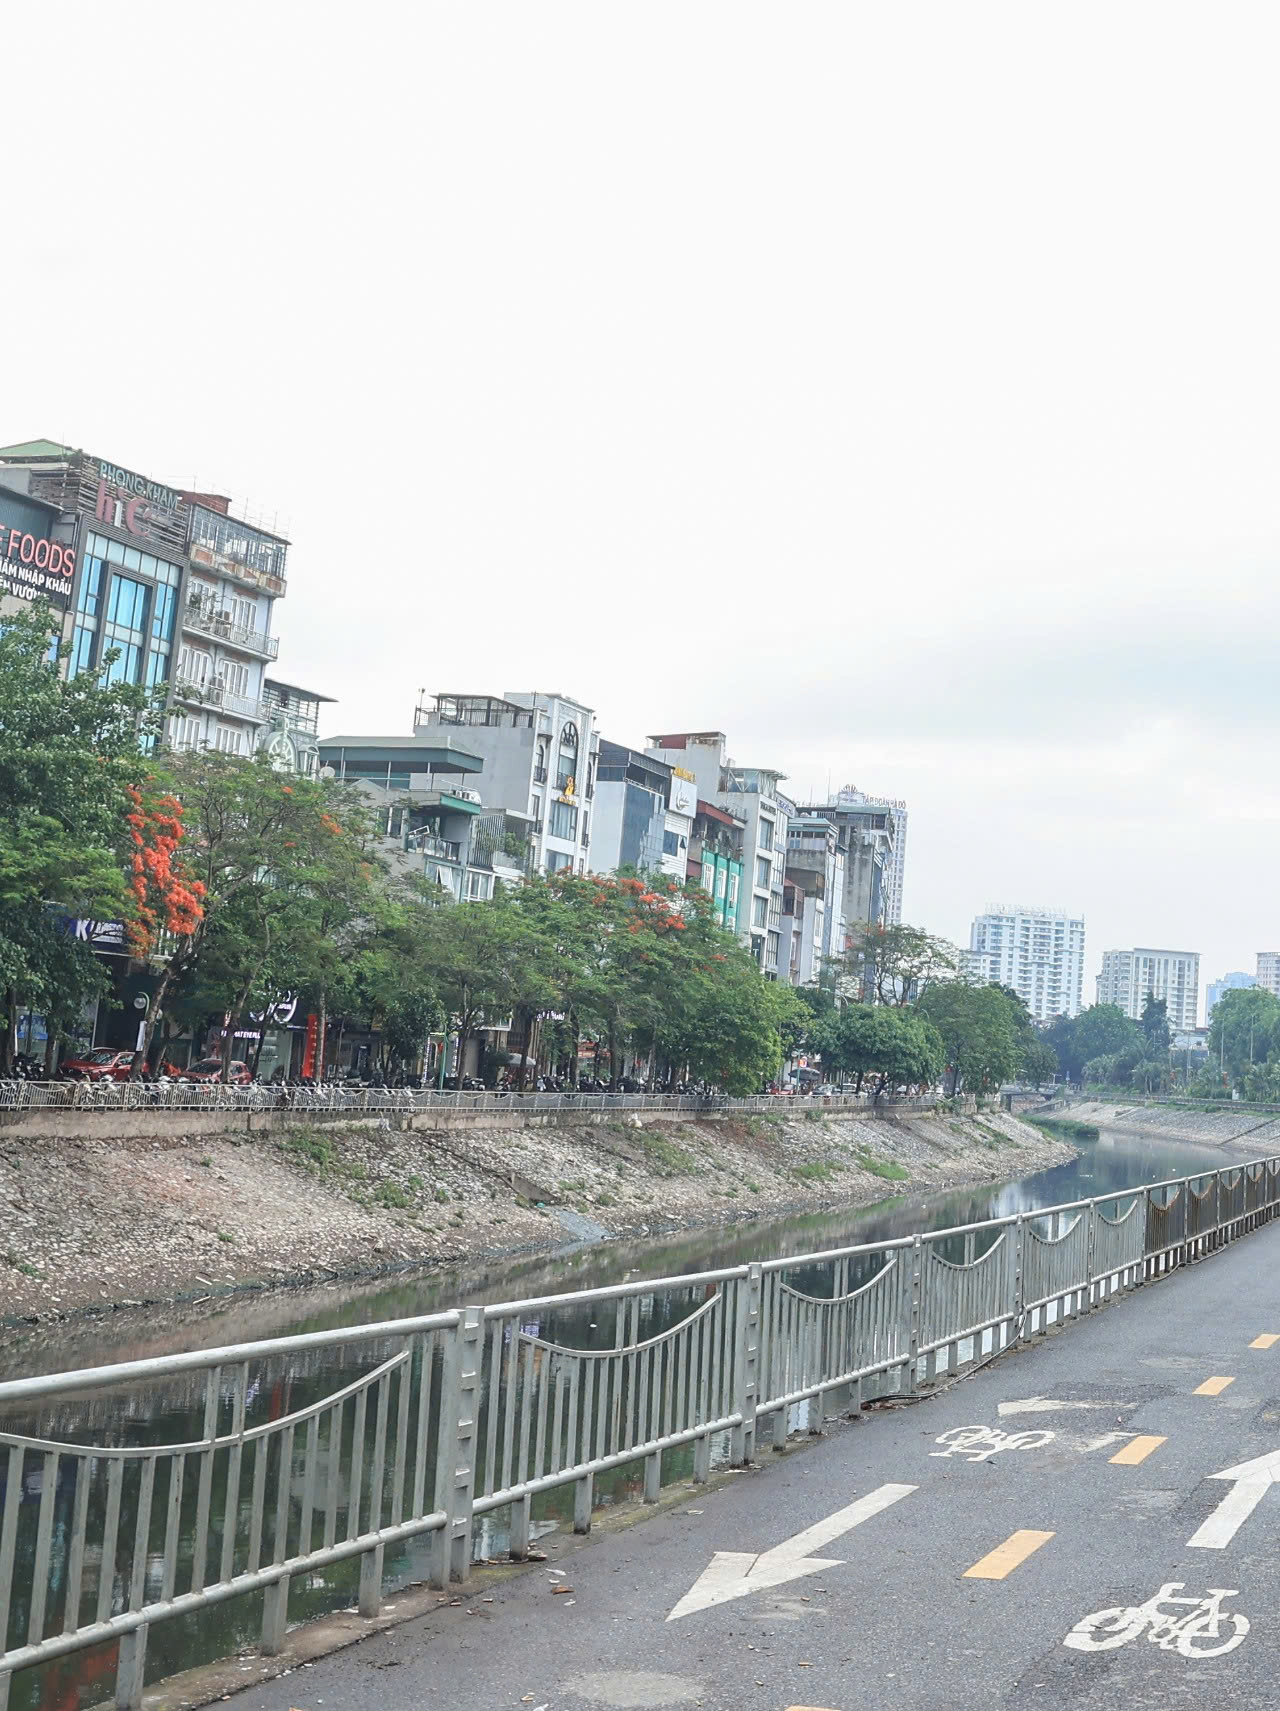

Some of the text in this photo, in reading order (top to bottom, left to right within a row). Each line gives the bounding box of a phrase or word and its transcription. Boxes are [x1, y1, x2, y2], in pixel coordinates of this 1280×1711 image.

[8, 529, 76, 577] FOODS
[18, 566, 45, 587] NHẬP
[45, 576, 71, 596] KHẨU
